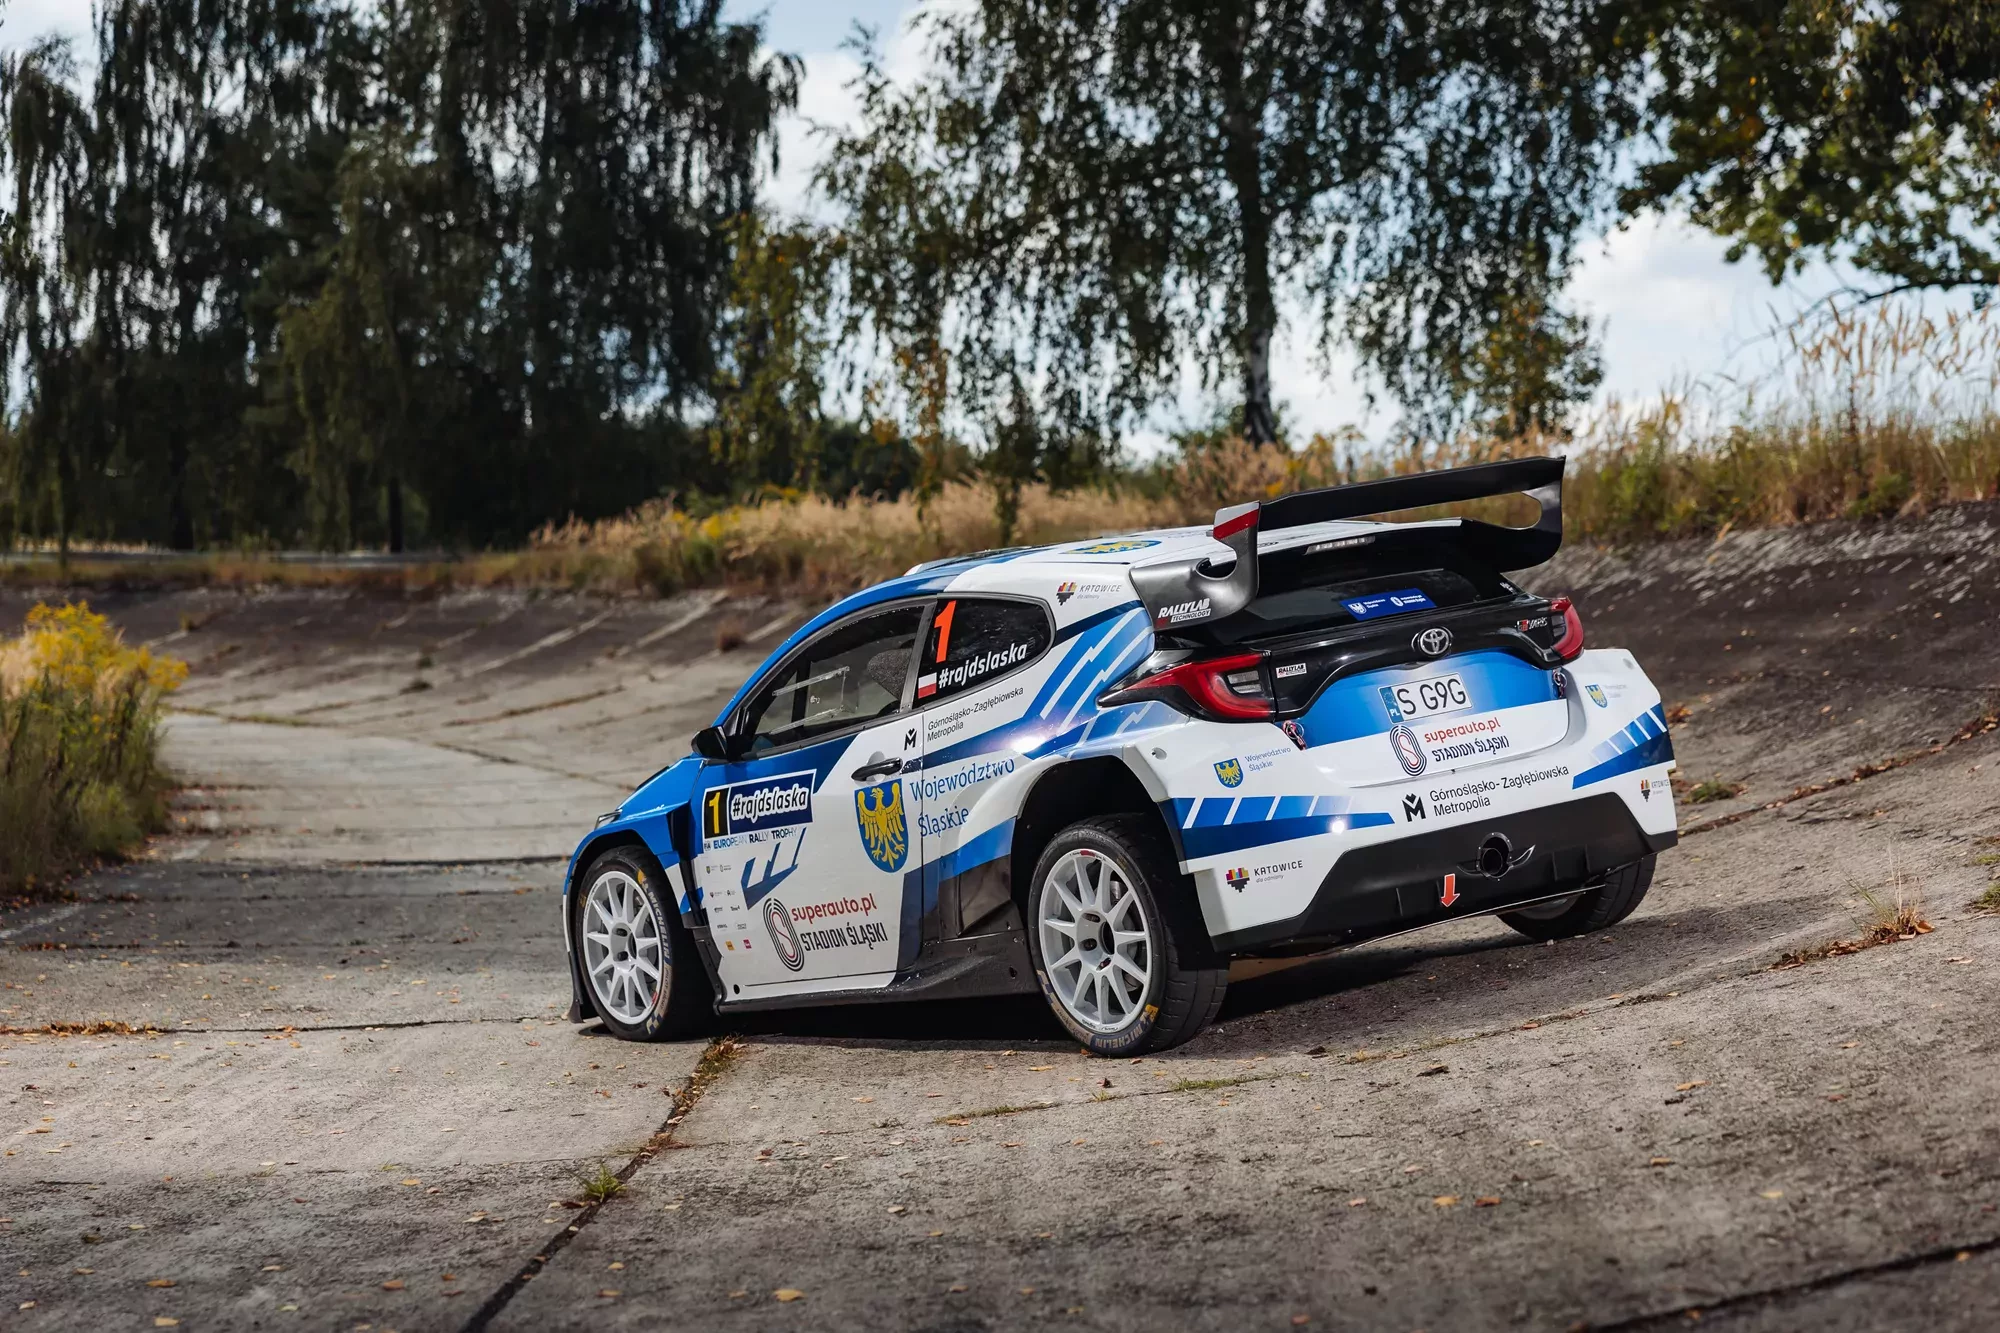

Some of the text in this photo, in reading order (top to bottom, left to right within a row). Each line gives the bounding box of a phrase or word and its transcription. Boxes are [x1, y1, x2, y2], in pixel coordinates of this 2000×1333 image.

[1079, 584, 1122, 593] KATOWICE
[1158, 597, 1210, 619] RALLYLAB
[1172, 609, 1210, 622] TECHNOLOGY
[934, 600, 957, 664] 1
[938, 643, 1028, 689] #rajdslaska
[928, 686, 1024, 731] Górnośląsko-Zagłębiowska
[1396, 678, 1467, 715] S G9G
[1389, 708, 1400, 717] PL
[927, 721, 964, 742] Metropolia
[1424, 717, 1501, 743] superauto.pl
[1244, 747, 1291, 763] Województwo
[1432, 735, 1510, 762] STADION ŚLĄSKI
[1248, 760, 1273, 772] Śląskie
[909, 758, 1015, 801] Województwo
[709, 791, 720, 834] 1
[732, 785, 808, 821] #rajdslaska
[1433, 795, 1491, 817] Metropolia
[918, 806, 969, 838] Śląskie
[713, 827, 798, 850] EUROPEAN RALLY TROPHY
[1254, 860, 1303, 877] KATOWICE
[791, 893, 877, 924] superauto.pl
[648, 891, 670, 959] MICHELIN
[800, 922, 888, 951] STADION ŚLĄSKI
[1095, 1026, 1143, 1049] MICHELIN
